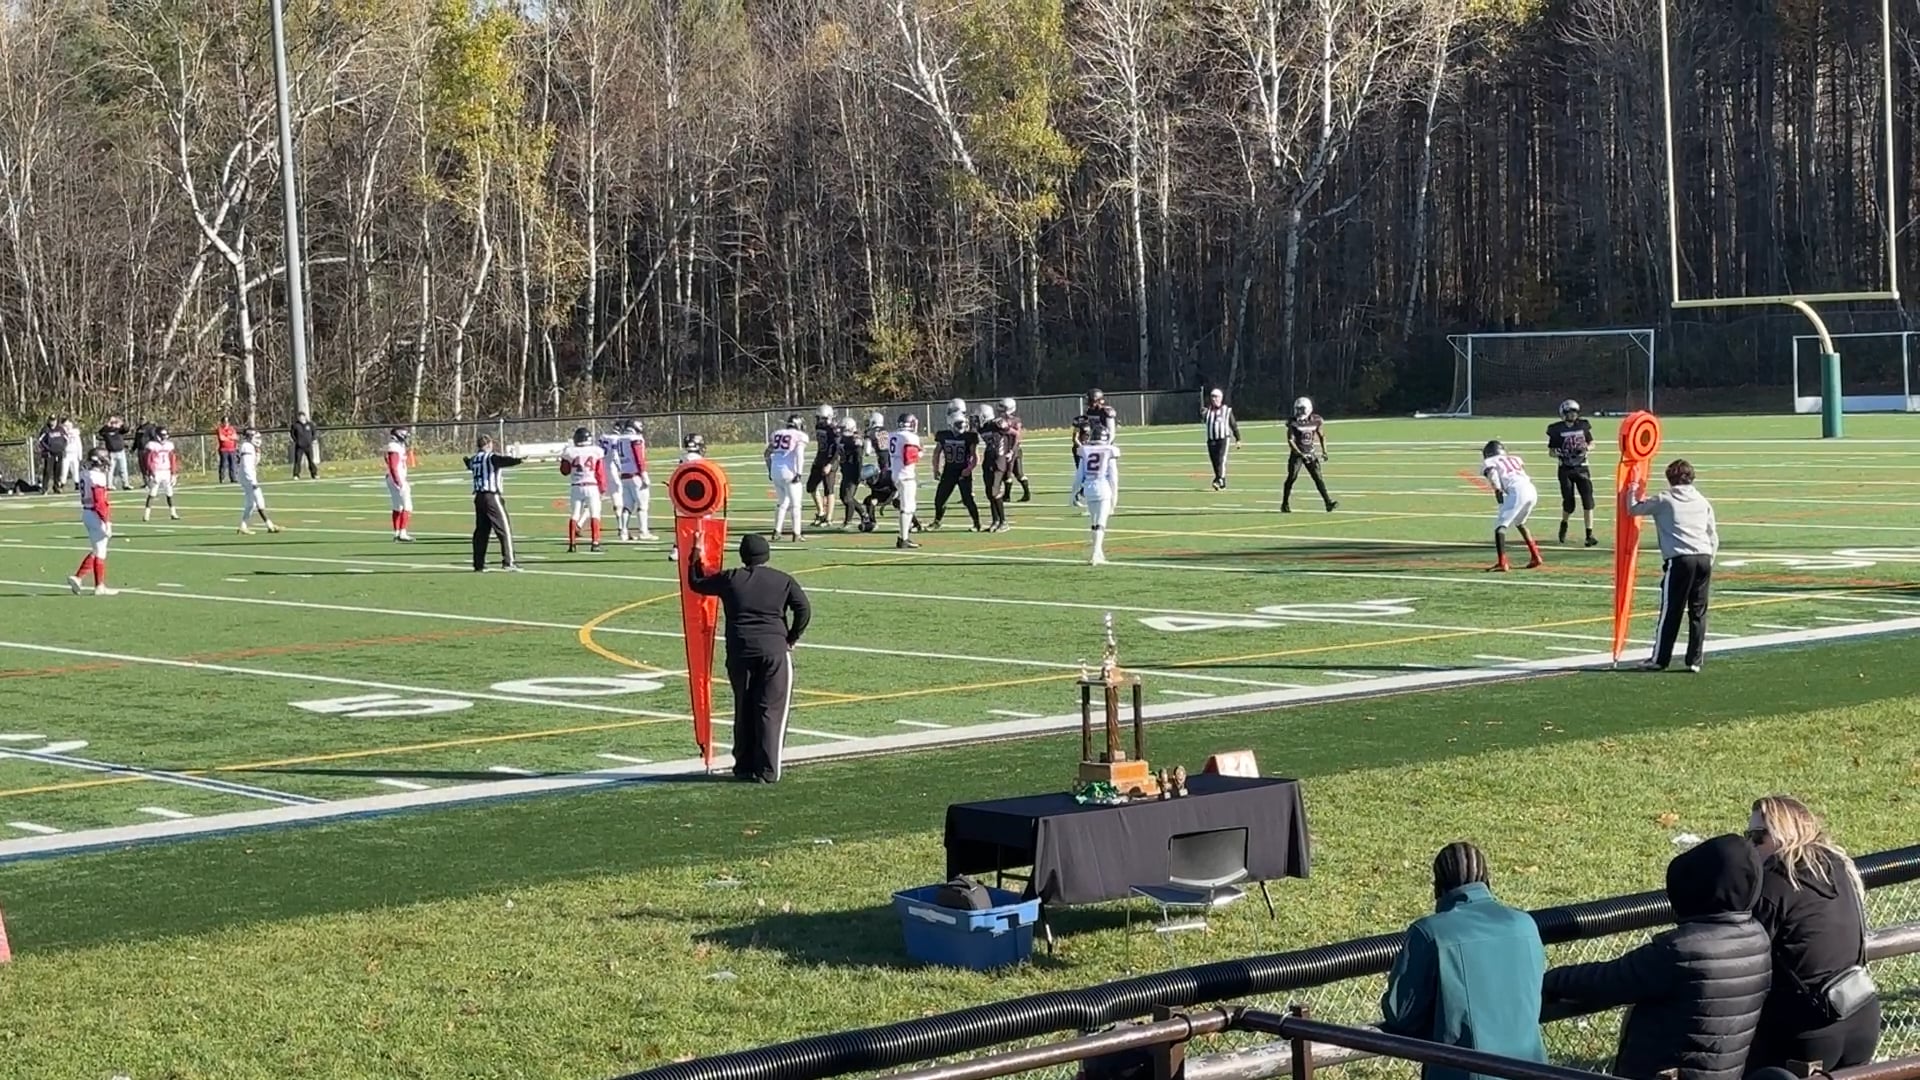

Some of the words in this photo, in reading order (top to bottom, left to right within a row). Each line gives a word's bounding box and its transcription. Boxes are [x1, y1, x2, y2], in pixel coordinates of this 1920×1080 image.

[774, 434, 792, 450] 99
[571, 456, 594, 473] 44
[1087, 453, 1100, 471] 2
[1499, 456, 1522, 474] 10
[1138, 602, 1415, 632] 40
[287, 676, 665, 717] 50
